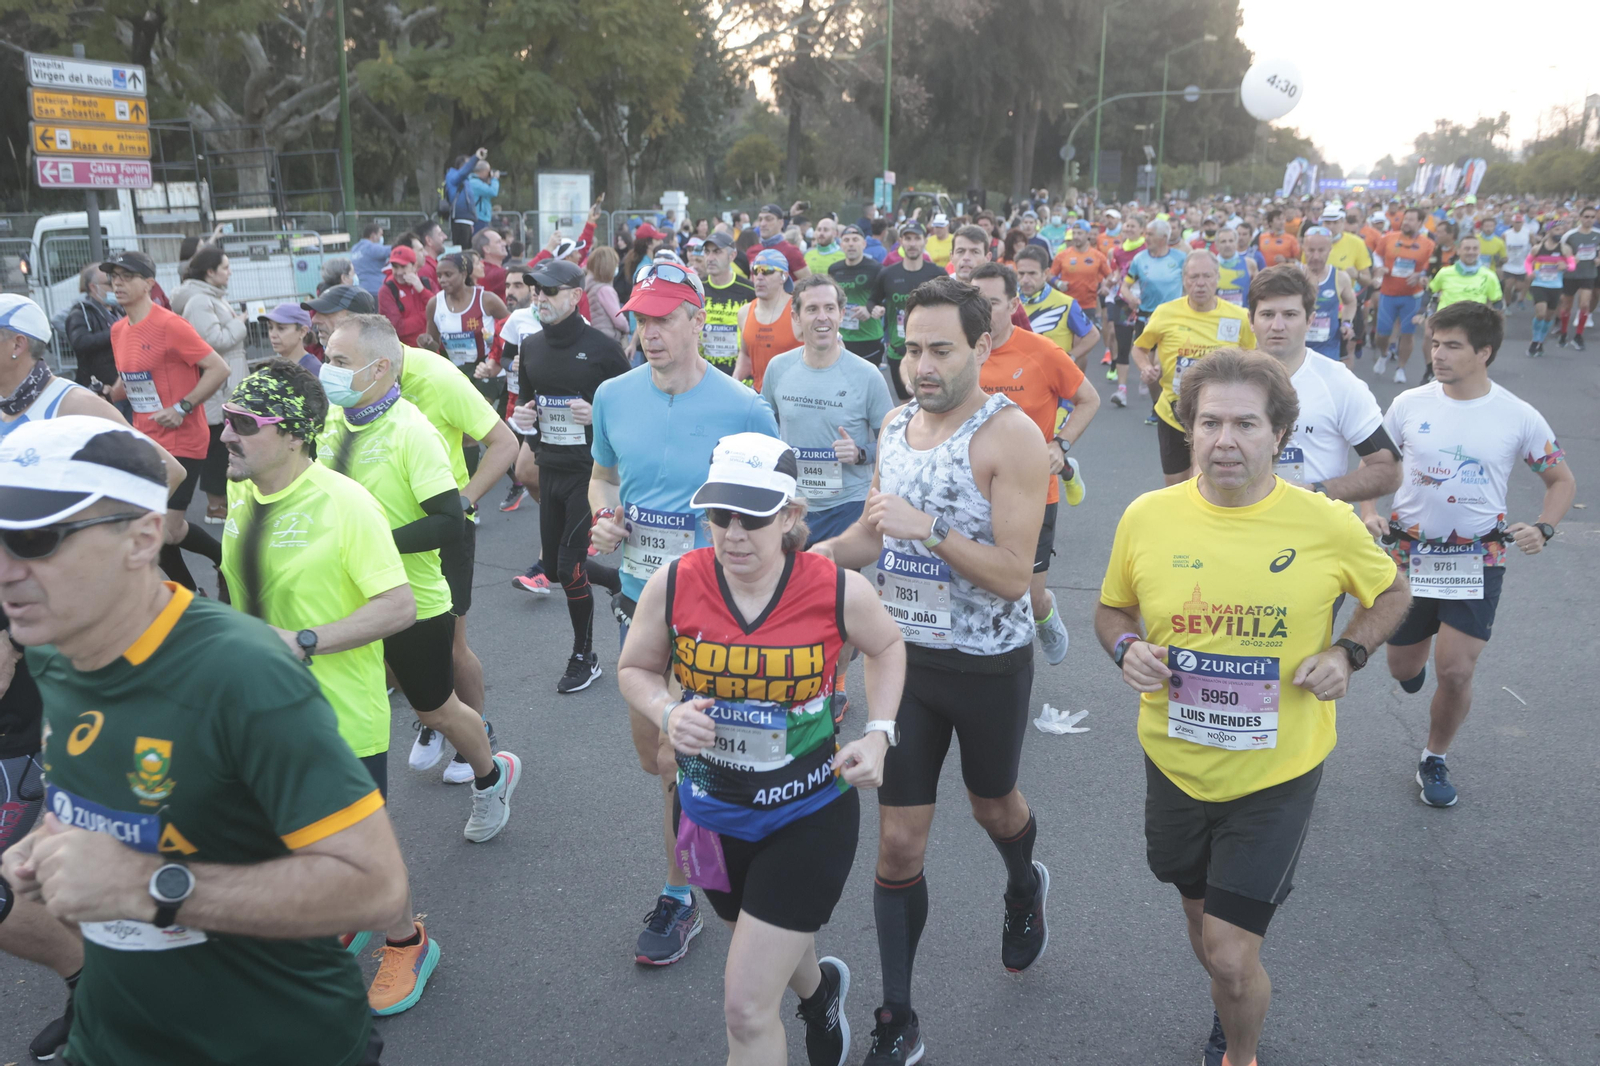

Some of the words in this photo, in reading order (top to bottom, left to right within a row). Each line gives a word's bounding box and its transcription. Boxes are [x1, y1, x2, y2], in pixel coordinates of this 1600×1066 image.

[34, 69, 65, 82] Virgen
[68, 74, 84, 84] del
[1267, 75, 1297, 98] 4:30
[72, 96, 98, 108] Prado
[37, 106, 56, 116] San
[72, 141, 98, 152] Plaza
[102, 143, 114, 152] de
[120, 143, 146, 154] Armas
[90, 162, 117, 174] Caixa
[120, 163, 148, 174] Forum
[89, 173, 114, 185] Torre
[118, 174, 148, 186] Sevilla
[782, 395, 814, 404] MARATÓN
[814, 399, 844, 408] SEVILLA
[550, 414, 566, 422] 9478
[804, 466, 822, 476] 8449
[1428, 466, 1450, 475] LUSO
[640, 512, 685, 526] ZURICH
[640, 534, 666, 550] 9133
[1434, 544, 1474, 554] ZURICH
[642, 554, 662, 566] JAZZ
[1434, 562, 1457, 571] 9781
[895, 558, 939, 576] ZURICH
[1410, 576, 1483, 584] FRANCISCOBRAGA
[896, 586, 919, 602] 7831
[911, 611, 937, 624] JOÃO
[1170, 614, 1288, 638] SEVILLA
[674, 635, 824, 678] SOUTH
[1200, 659, 1265, 675] ZURICH
[676, 663, 822, 703] AFRICA
[1201, 688, 1239, 706] 5950
[710, 705, 772, 725] ZURICH
[1180, 707, 1206, 722] LUIS
[1209, 713, 1262, 727] MENDES
[74, 806, 142, 844] ZURICH
